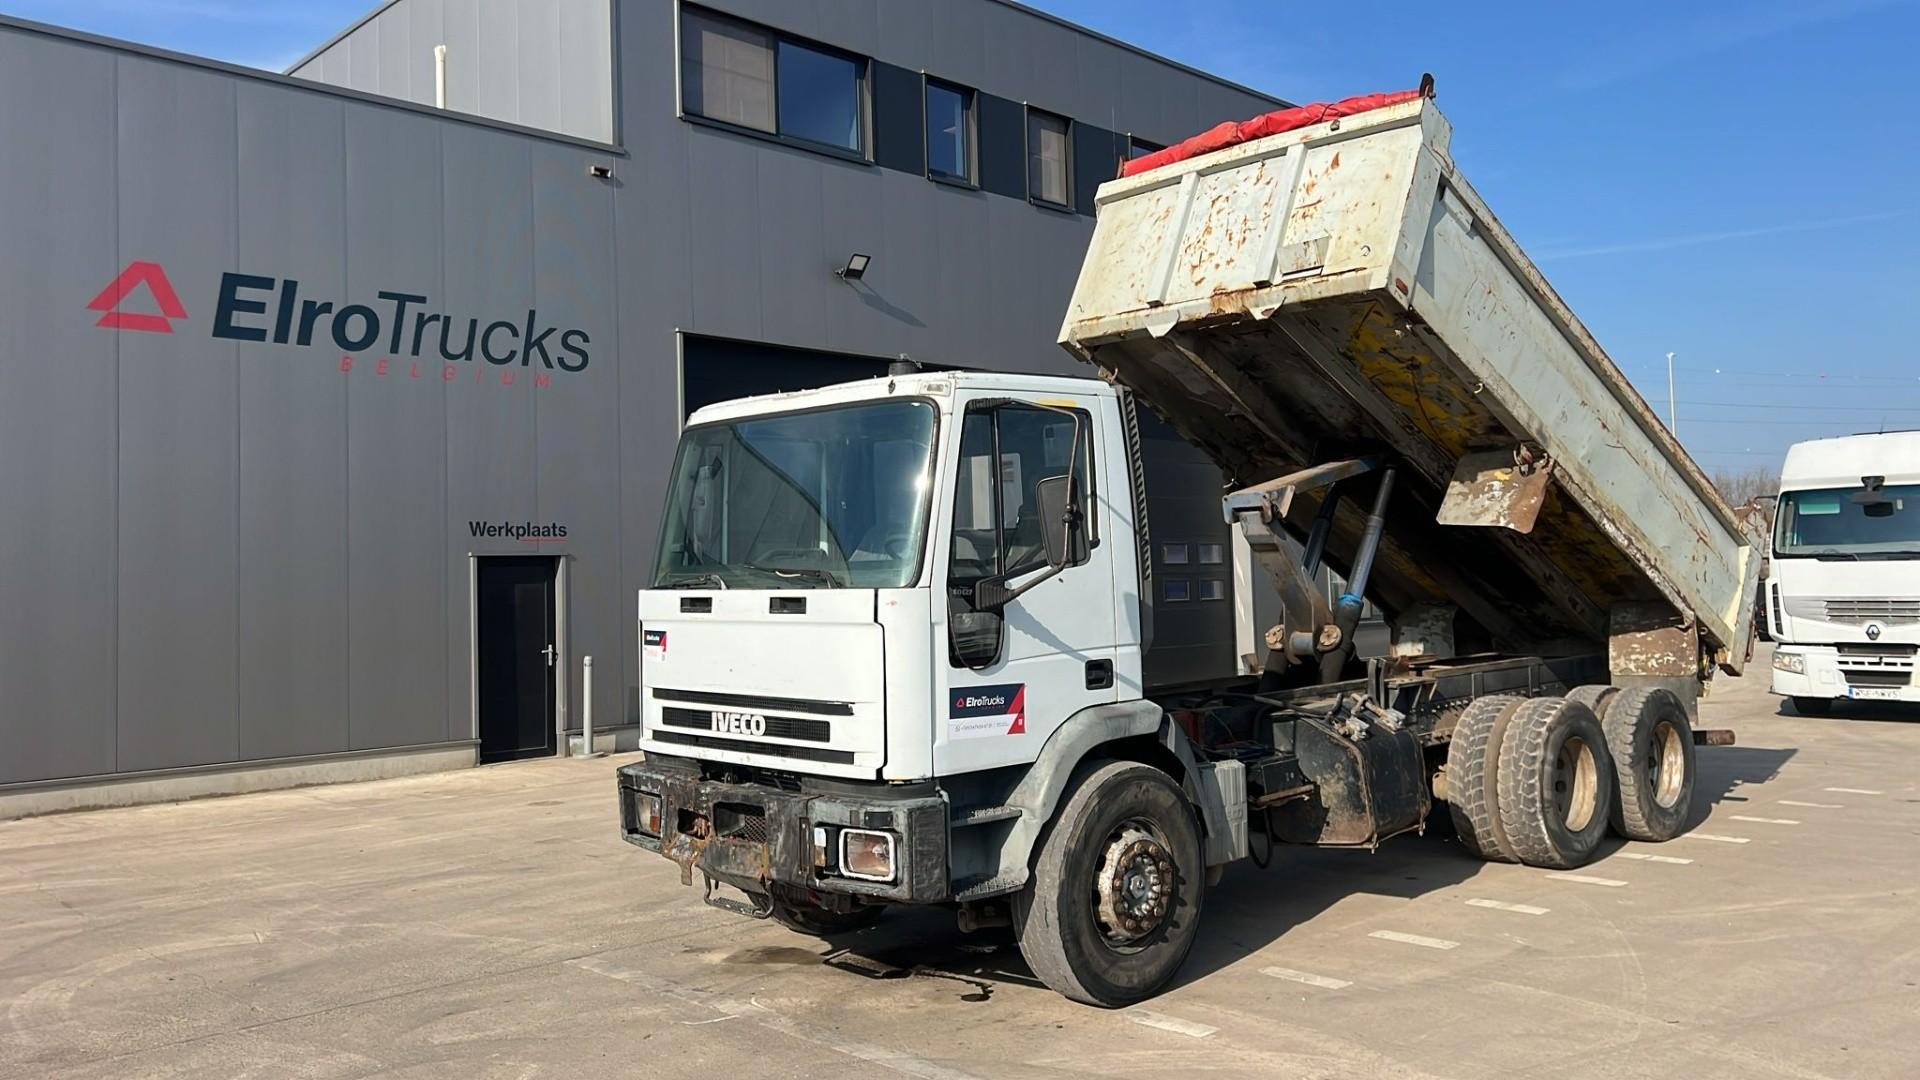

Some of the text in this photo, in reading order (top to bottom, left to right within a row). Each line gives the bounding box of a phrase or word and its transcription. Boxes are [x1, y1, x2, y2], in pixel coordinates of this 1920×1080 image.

[211, 271, 591, 372] ElroTrucks
[339, 356, 552, 388] BELGIUM
[468, 521, 568, 540] Werkplaats
[966, 696, 1005, 707] ElroTrucks
[711, 711, 766, 736] IVECO
